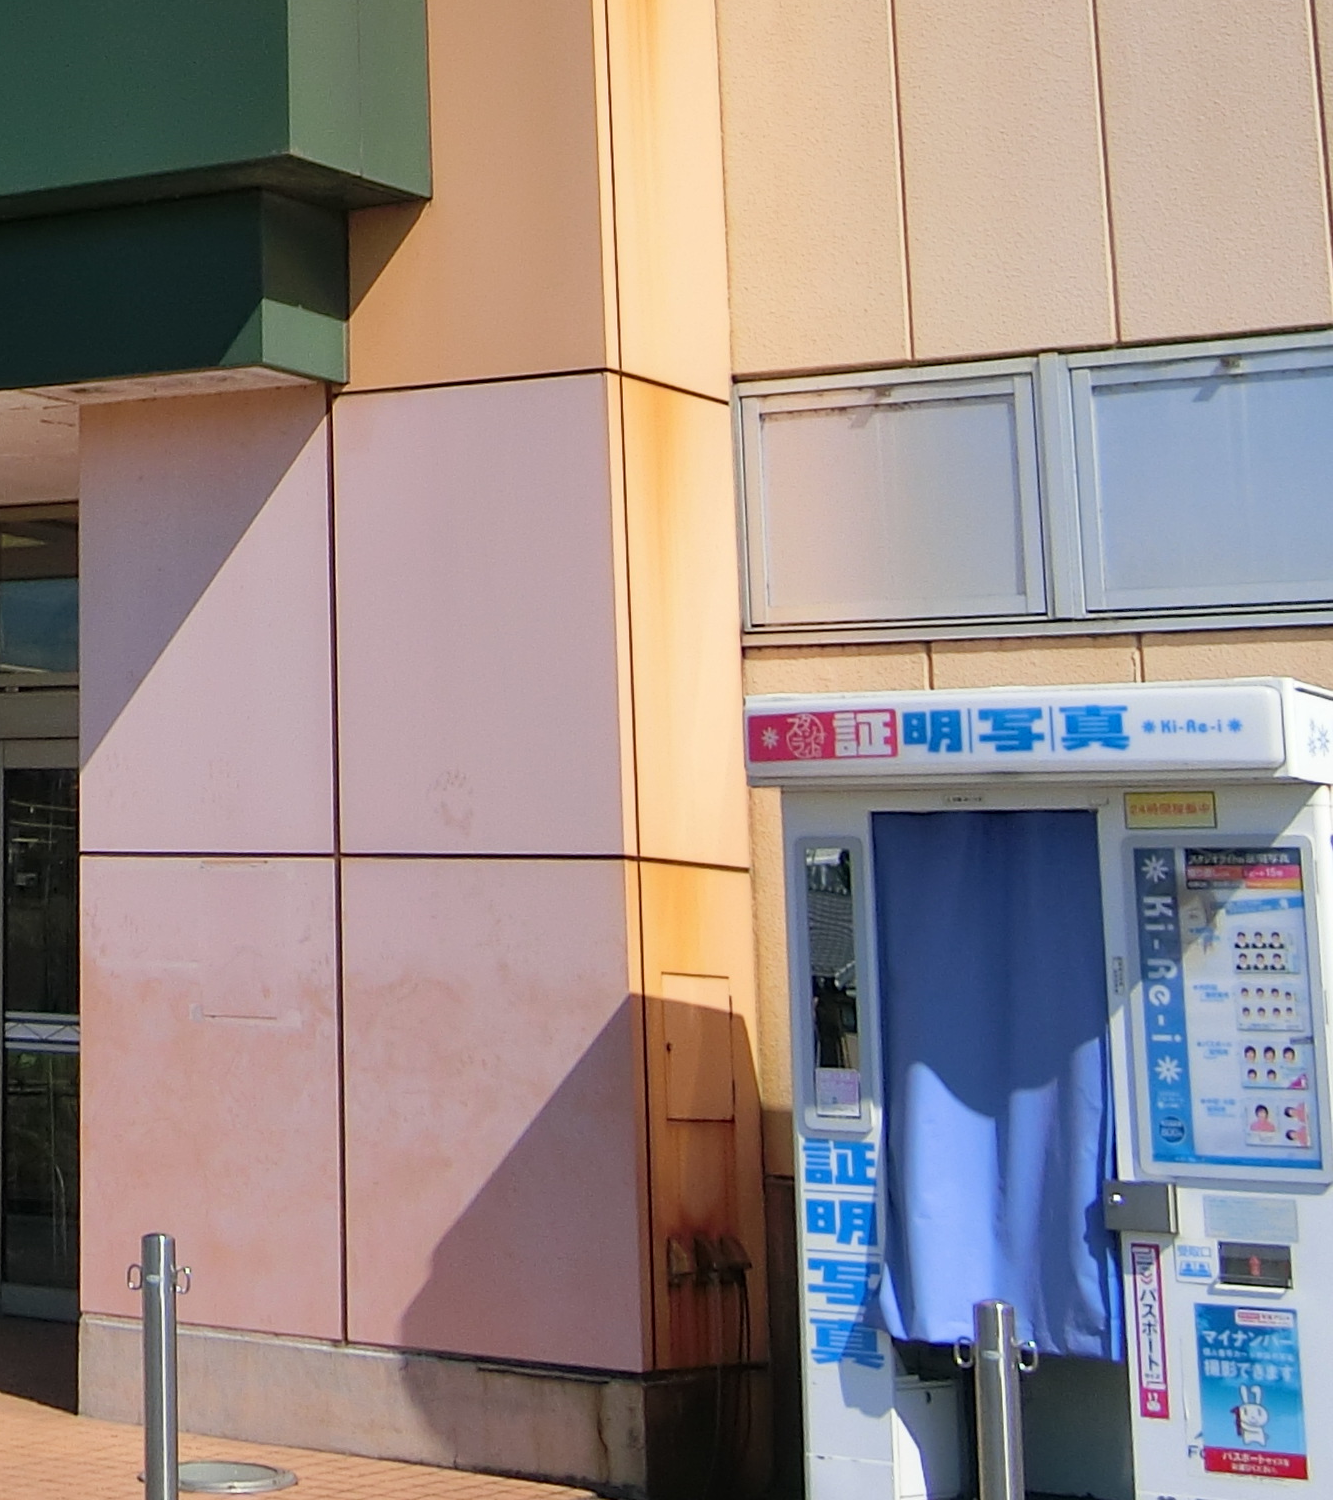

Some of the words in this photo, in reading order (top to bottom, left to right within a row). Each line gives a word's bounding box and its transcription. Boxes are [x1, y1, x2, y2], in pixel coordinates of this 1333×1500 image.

[833, 704, 1131, 757] 証明写真
[1161, 719, 1222, 734] Ki-Re-i
[1142, 894, 1182, 1043] Ki-Re-i
[803, 1138, 885, 1370] 証明写真
[1201, 1329, 1294, 1348] マイナンバー
[1204, 1358, 1294, 1383] 撮影できます
